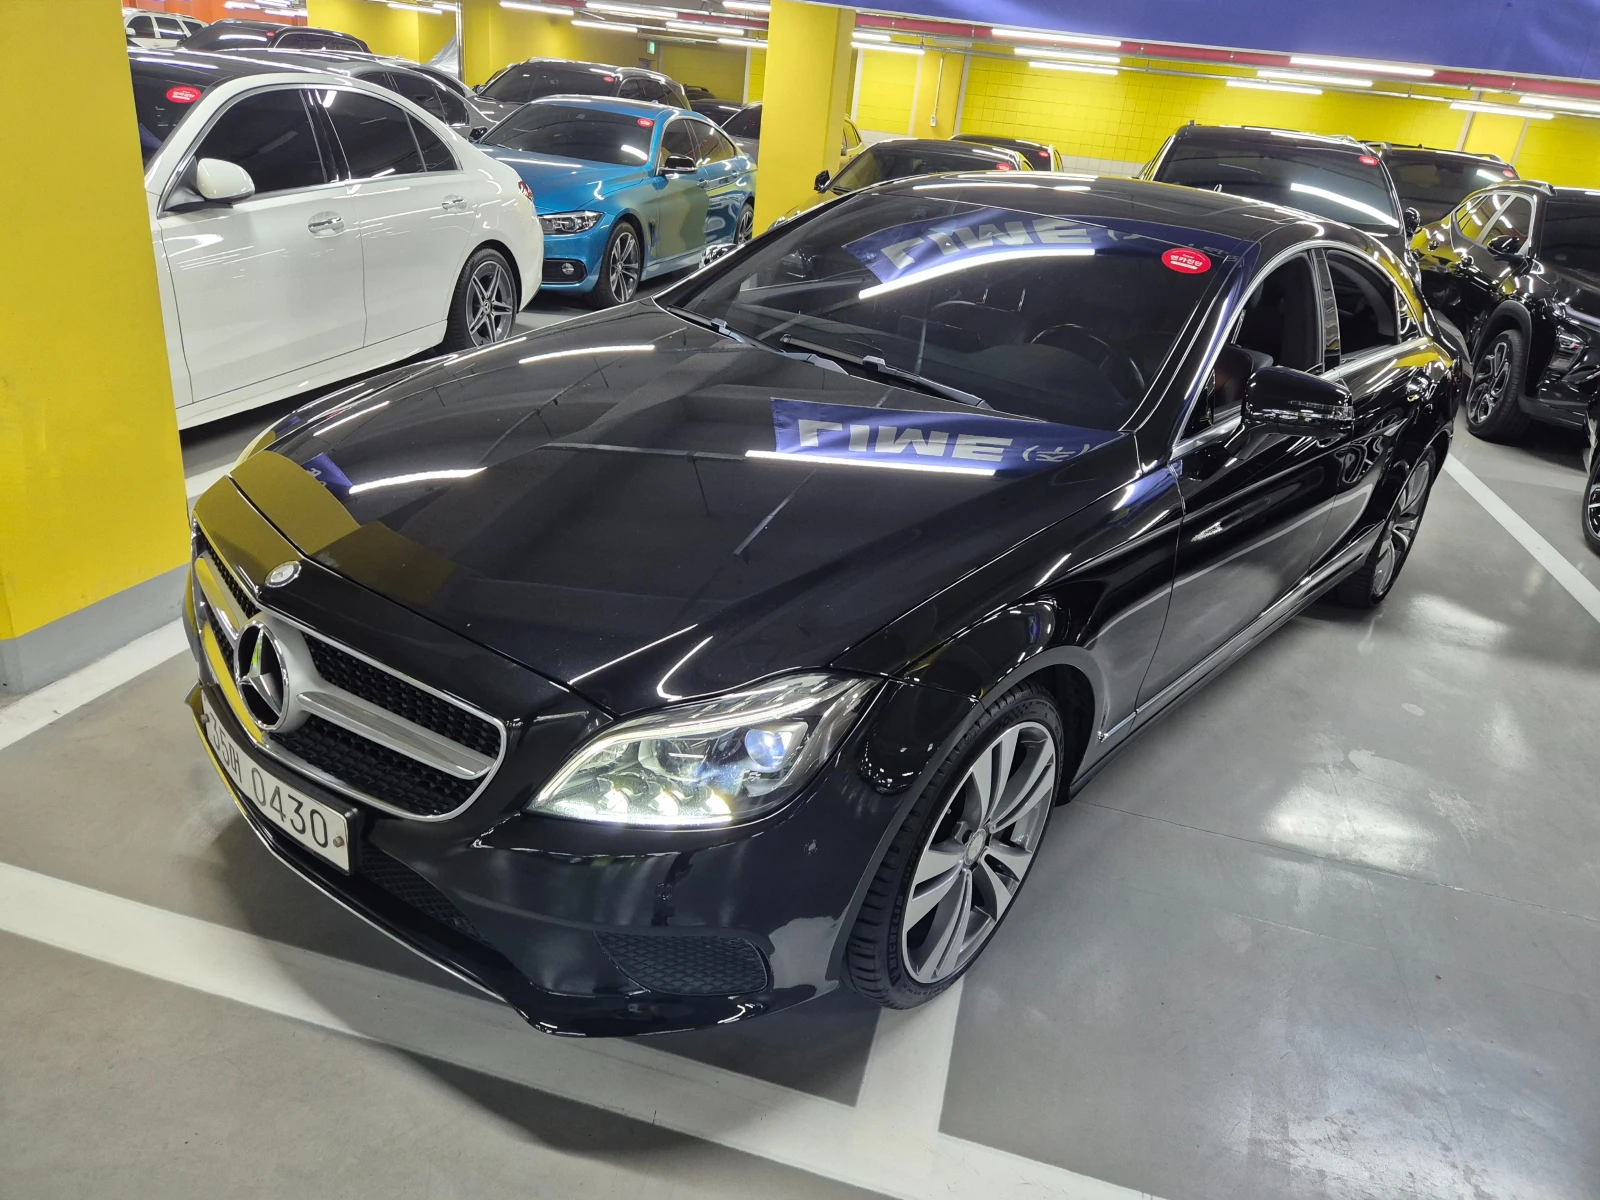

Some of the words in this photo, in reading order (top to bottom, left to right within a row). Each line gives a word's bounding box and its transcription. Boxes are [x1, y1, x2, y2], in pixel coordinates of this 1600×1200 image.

[209, 711, 242, 784] 35머
[251, 767, 329, 849] 0430
[888, 894, 904, 970] MICHELIN
